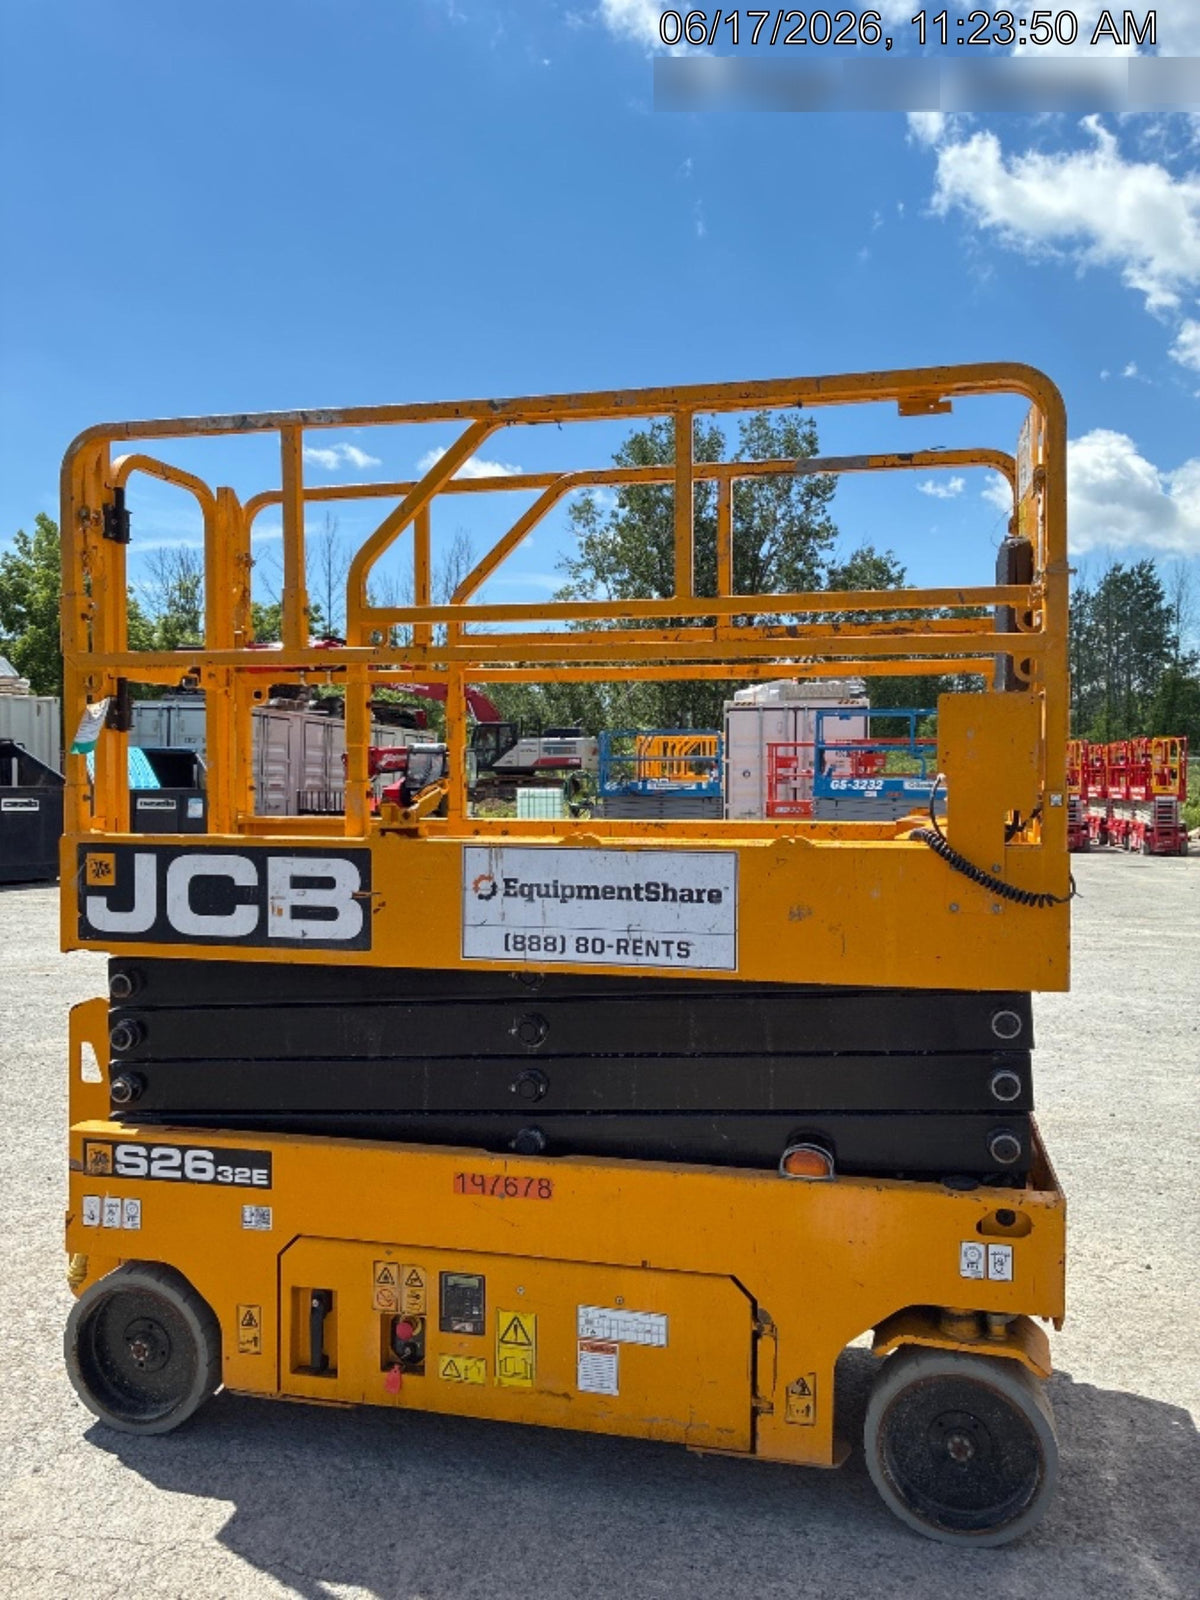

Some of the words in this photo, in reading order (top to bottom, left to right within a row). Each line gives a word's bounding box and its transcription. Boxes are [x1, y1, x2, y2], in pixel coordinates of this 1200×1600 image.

[830, 779, 884, 790] GS-3232
[86, 853, 363, 939] JCB
[502, 878, 722, 904] EquipmentShare
[504, 933, 566, 955] (888)
[575, 936, 691, 959] 80-RENTS
